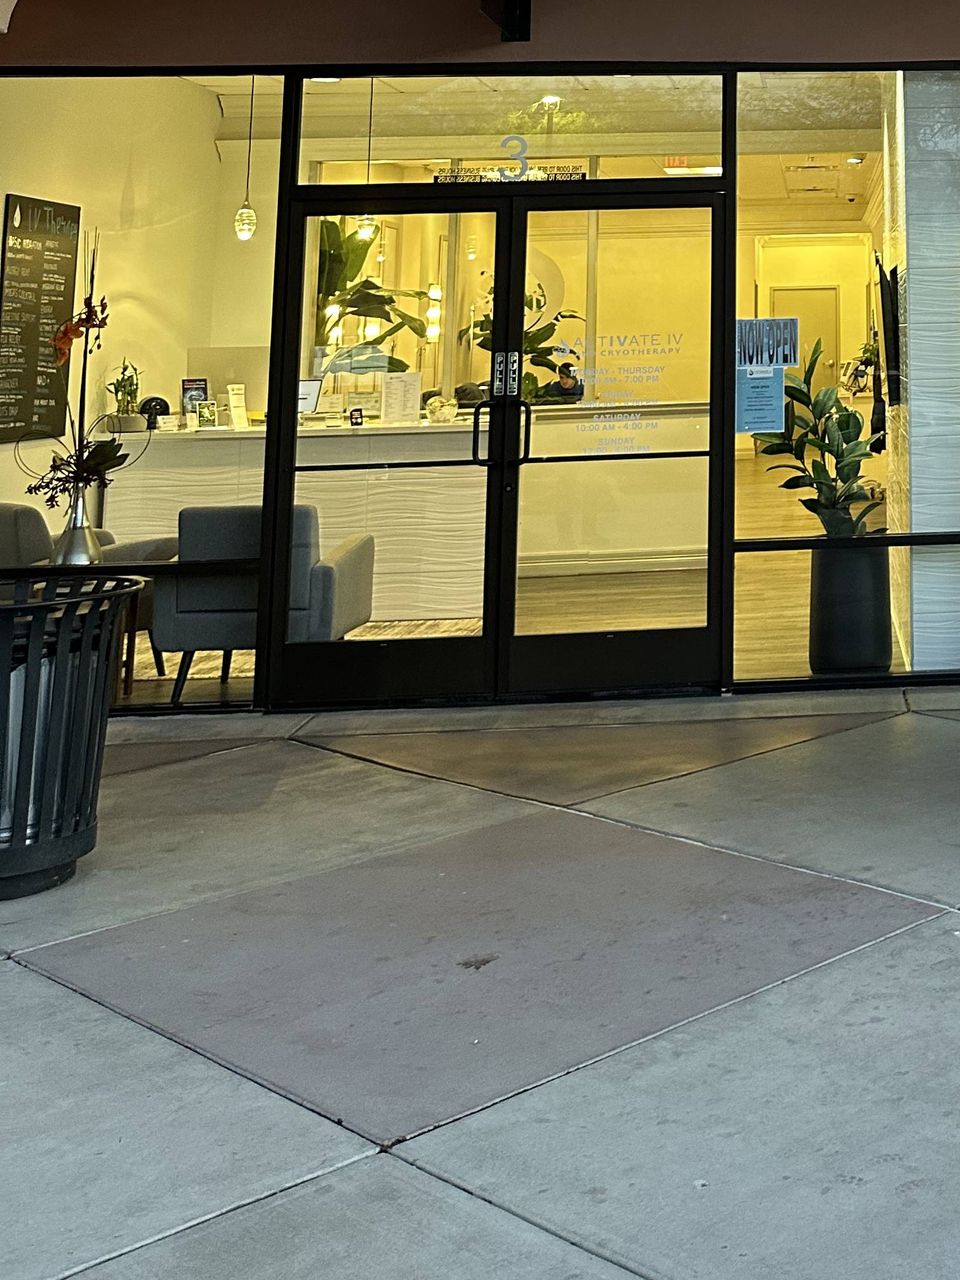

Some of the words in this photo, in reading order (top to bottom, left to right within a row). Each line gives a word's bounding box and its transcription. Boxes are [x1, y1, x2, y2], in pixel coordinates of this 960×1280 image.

[500, 135, 528, 182] 3
[573, 333, 661, 348] ATIVATE
[667, 333, 684, 345] IV
[739, 321, 764, 366] NOW
[767, 320, 797, 365] OPEN
[600, 347, 681, 357] CRYOTHERAPY
[496, 355, 504, 386] PULL
[618, 365, 665, 375] THURSDAY
[593, 413, 641, 423] SATURDAY
[576, 423, 600, 432] 10:00
[602, 423, 615, 431] AM
[624, 422, 642, 431] 4:00
[646, 421, 659, 430] PM
